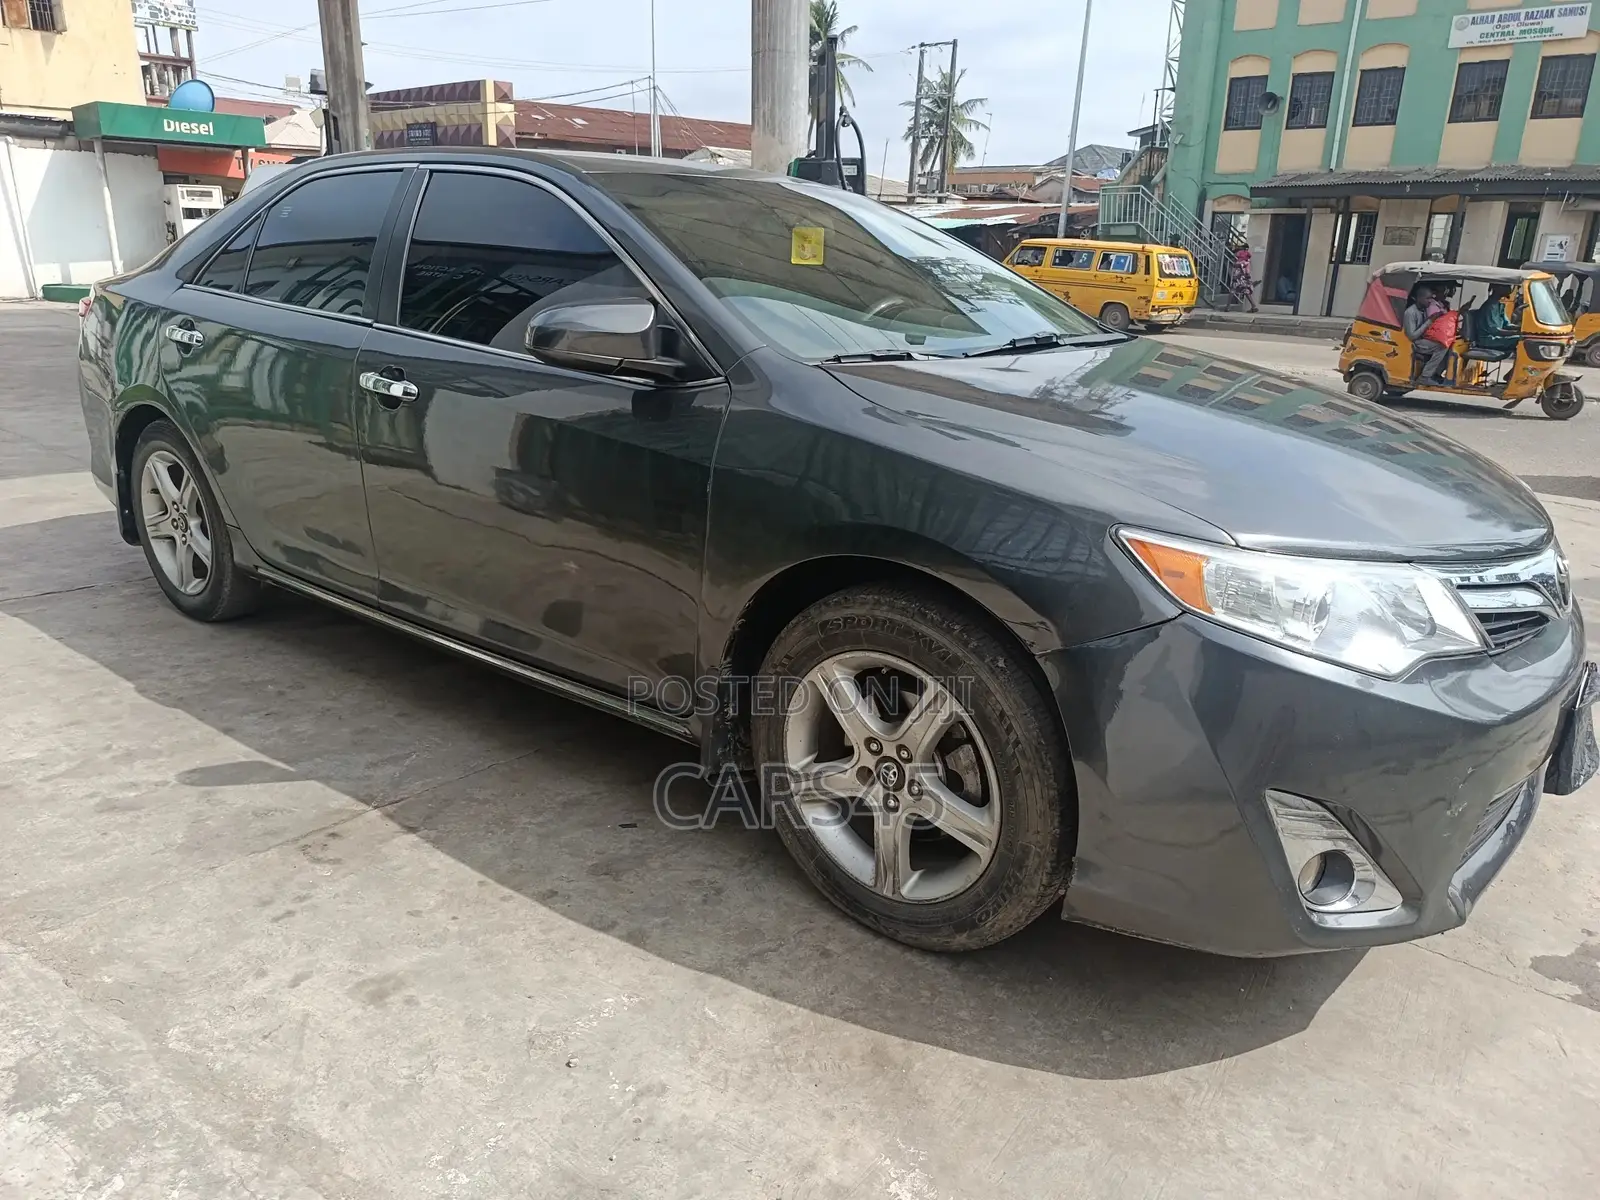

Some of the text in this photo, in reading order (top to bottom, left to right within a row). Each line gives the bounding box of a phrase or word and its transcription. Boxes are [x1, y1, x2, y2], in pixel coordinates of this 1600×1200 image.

[1497, 14, 1521, 24] ABDUL
[1524, 8, 1556, 21] RAZAAK
[1557, 5, 1588, 18] SANUSI
[1479, 26, 1555, 39] CENTRAL MOSQUE
[163, 118, 215, 137] Diesel
